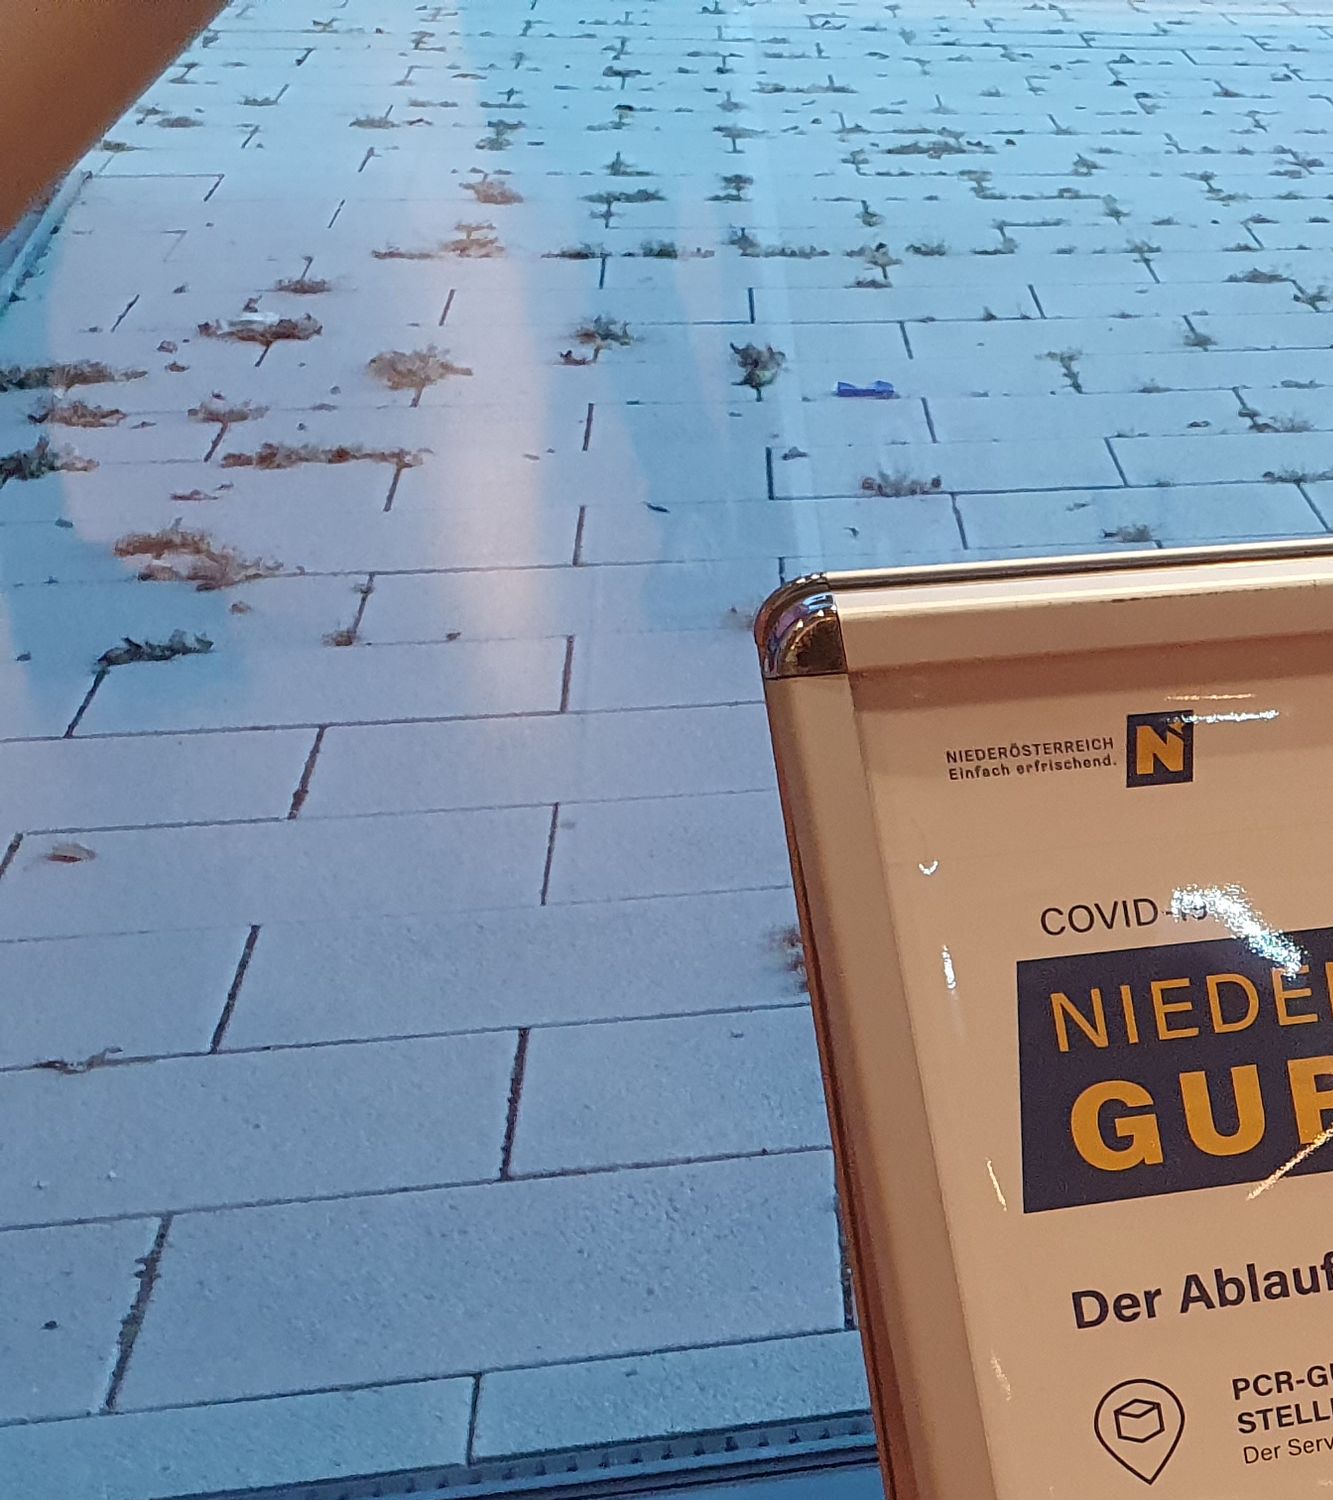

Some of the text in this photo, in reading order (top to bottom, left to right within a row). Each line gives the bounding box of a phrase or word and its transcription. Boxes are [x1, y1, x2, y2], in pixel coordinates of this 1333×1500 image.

[946, 736, 1115, 764] NIEDERÖSTERREICH
[948, 753, 1118, 781] Einfach erfrischend.
[1072, 1289, 1161, 1329] Der
[1244, 1446, 1280, 1463] Der
